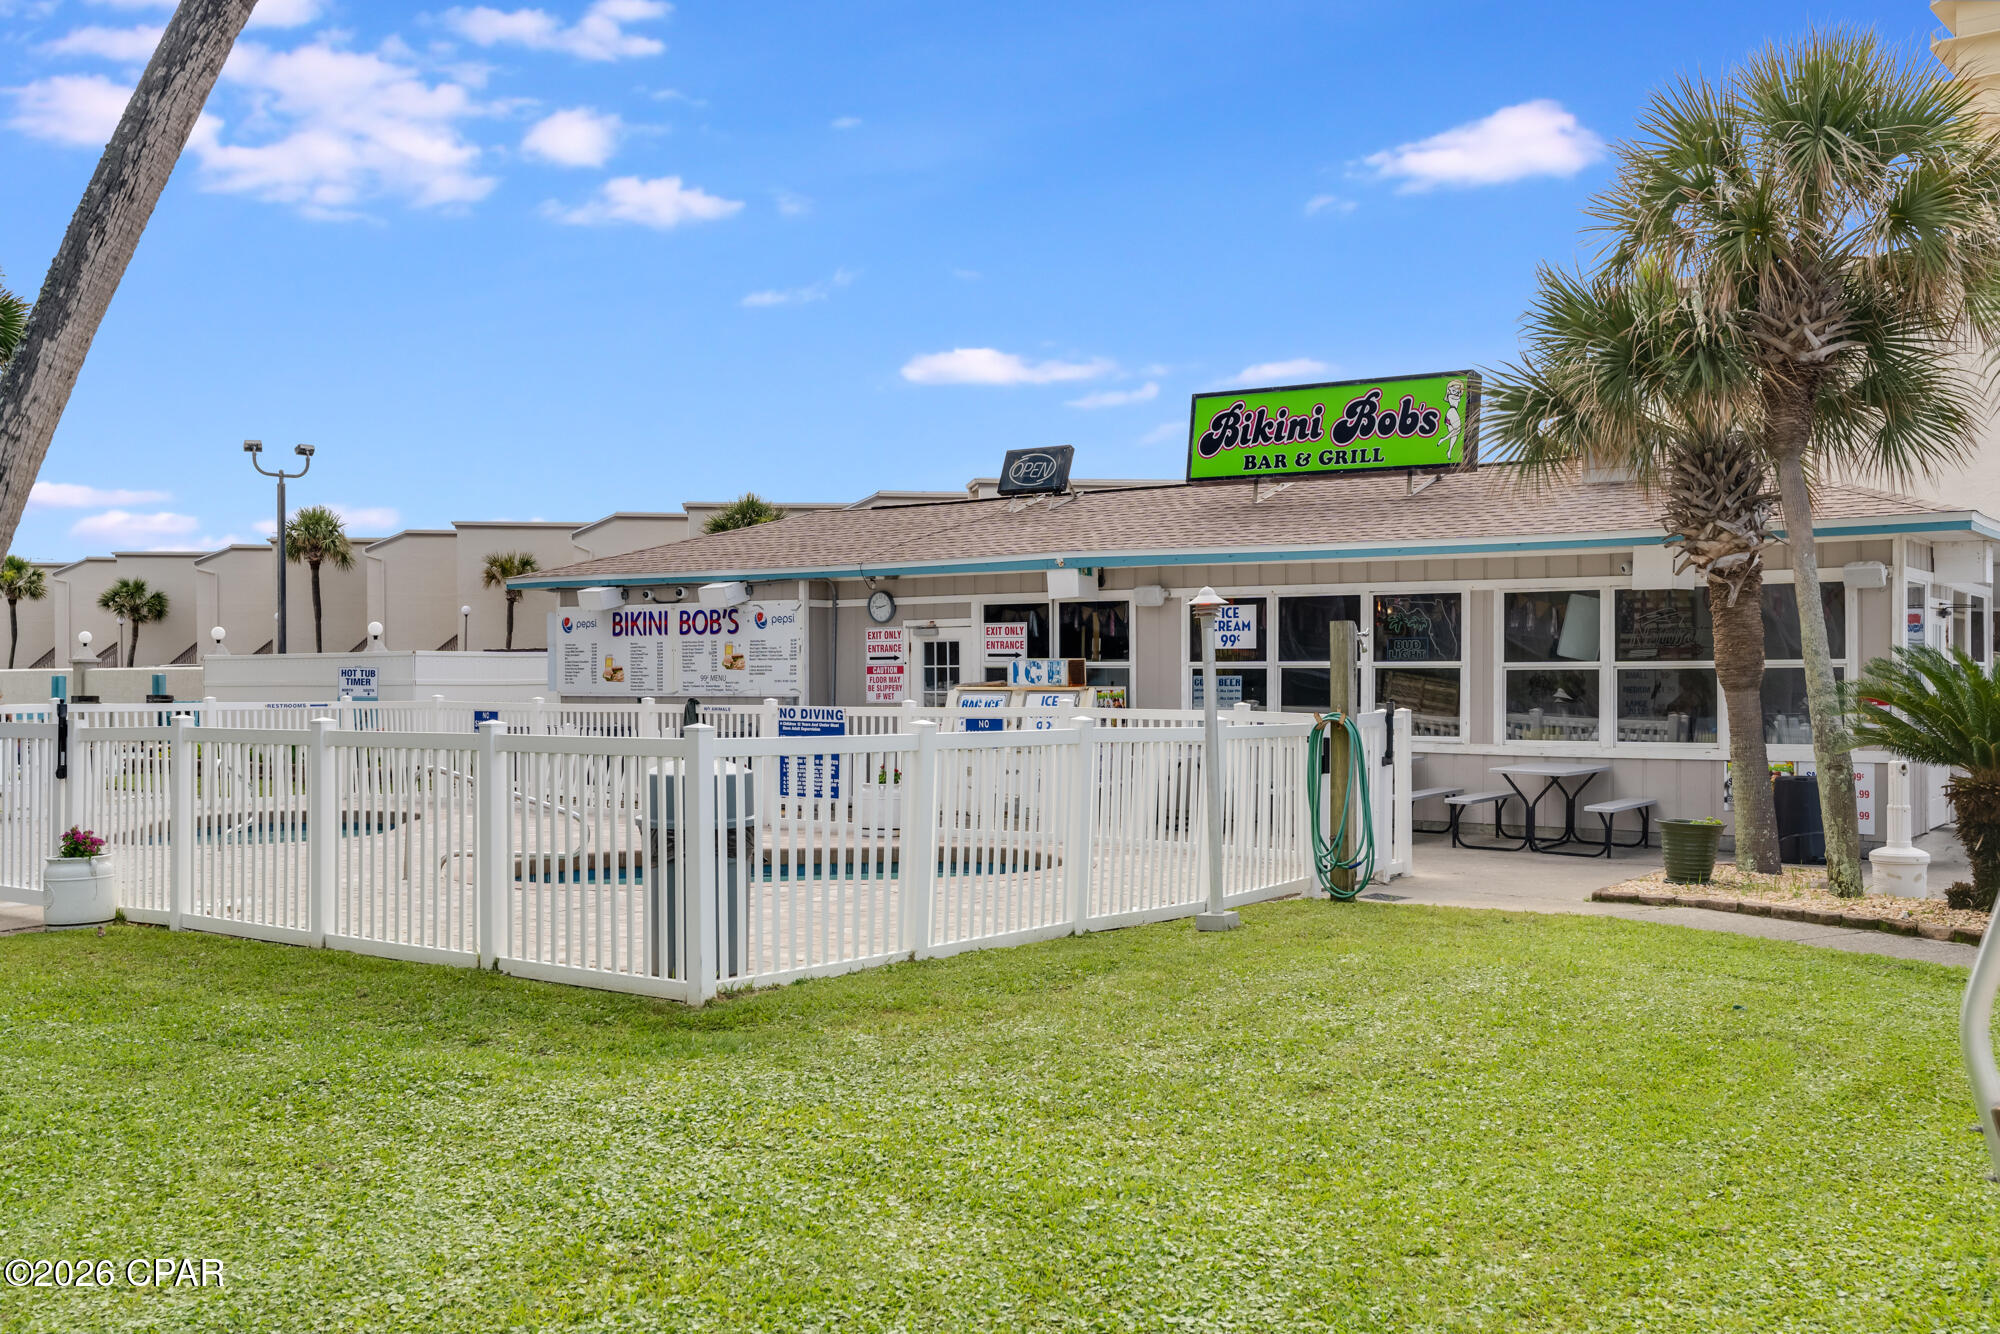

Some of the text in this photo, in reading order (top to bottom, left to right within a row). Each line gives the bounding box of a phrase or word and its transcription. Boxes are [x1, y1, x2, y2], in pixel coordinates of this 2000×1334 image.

[1198, 389, 1441, 458] Bikini Bob's
[1243, 447, 1384, 470] BAR & GRILL
[1012, 462, 1053, 477] OPEN
[1221, 607, 1239, 618] ICE
[576, 619, 597, 630] pepsi
[612, 608, 740, 637] BIKINI BOB'S
[771, 613, 795, 625] pepsi
[986, 626, 1024, 636] EXIT ONLY
[1214, 620, 1250, 632] REAM
[867, 630, 902, 640] EXIT ONLY
[1220, 634, 1240, 647] 99¢
[868, 644, 902, 653] ENTRANCE
[986, 641, 1024, 650] ENTRANCE
[1394, 640, 1421, 650] BUD
[1389, 649, 1425, 660] LIGHT
[341, 669, 376, 677] HOT TUB
[1012, 659, 1063, 684] ICE
[345, 677, 371, 686] TIMER
[1218, 678, 1241, 687] BEER
[876, 684, 903, 692] SLIPPERY
[876, 692, 894, 700] IF WET
[1041, 695, 1059, 707] ICE
[482, 711, 490, 719] NO
[780, 708, 844, 720] NO DIVING
[978, 720, 989, 728] NO
